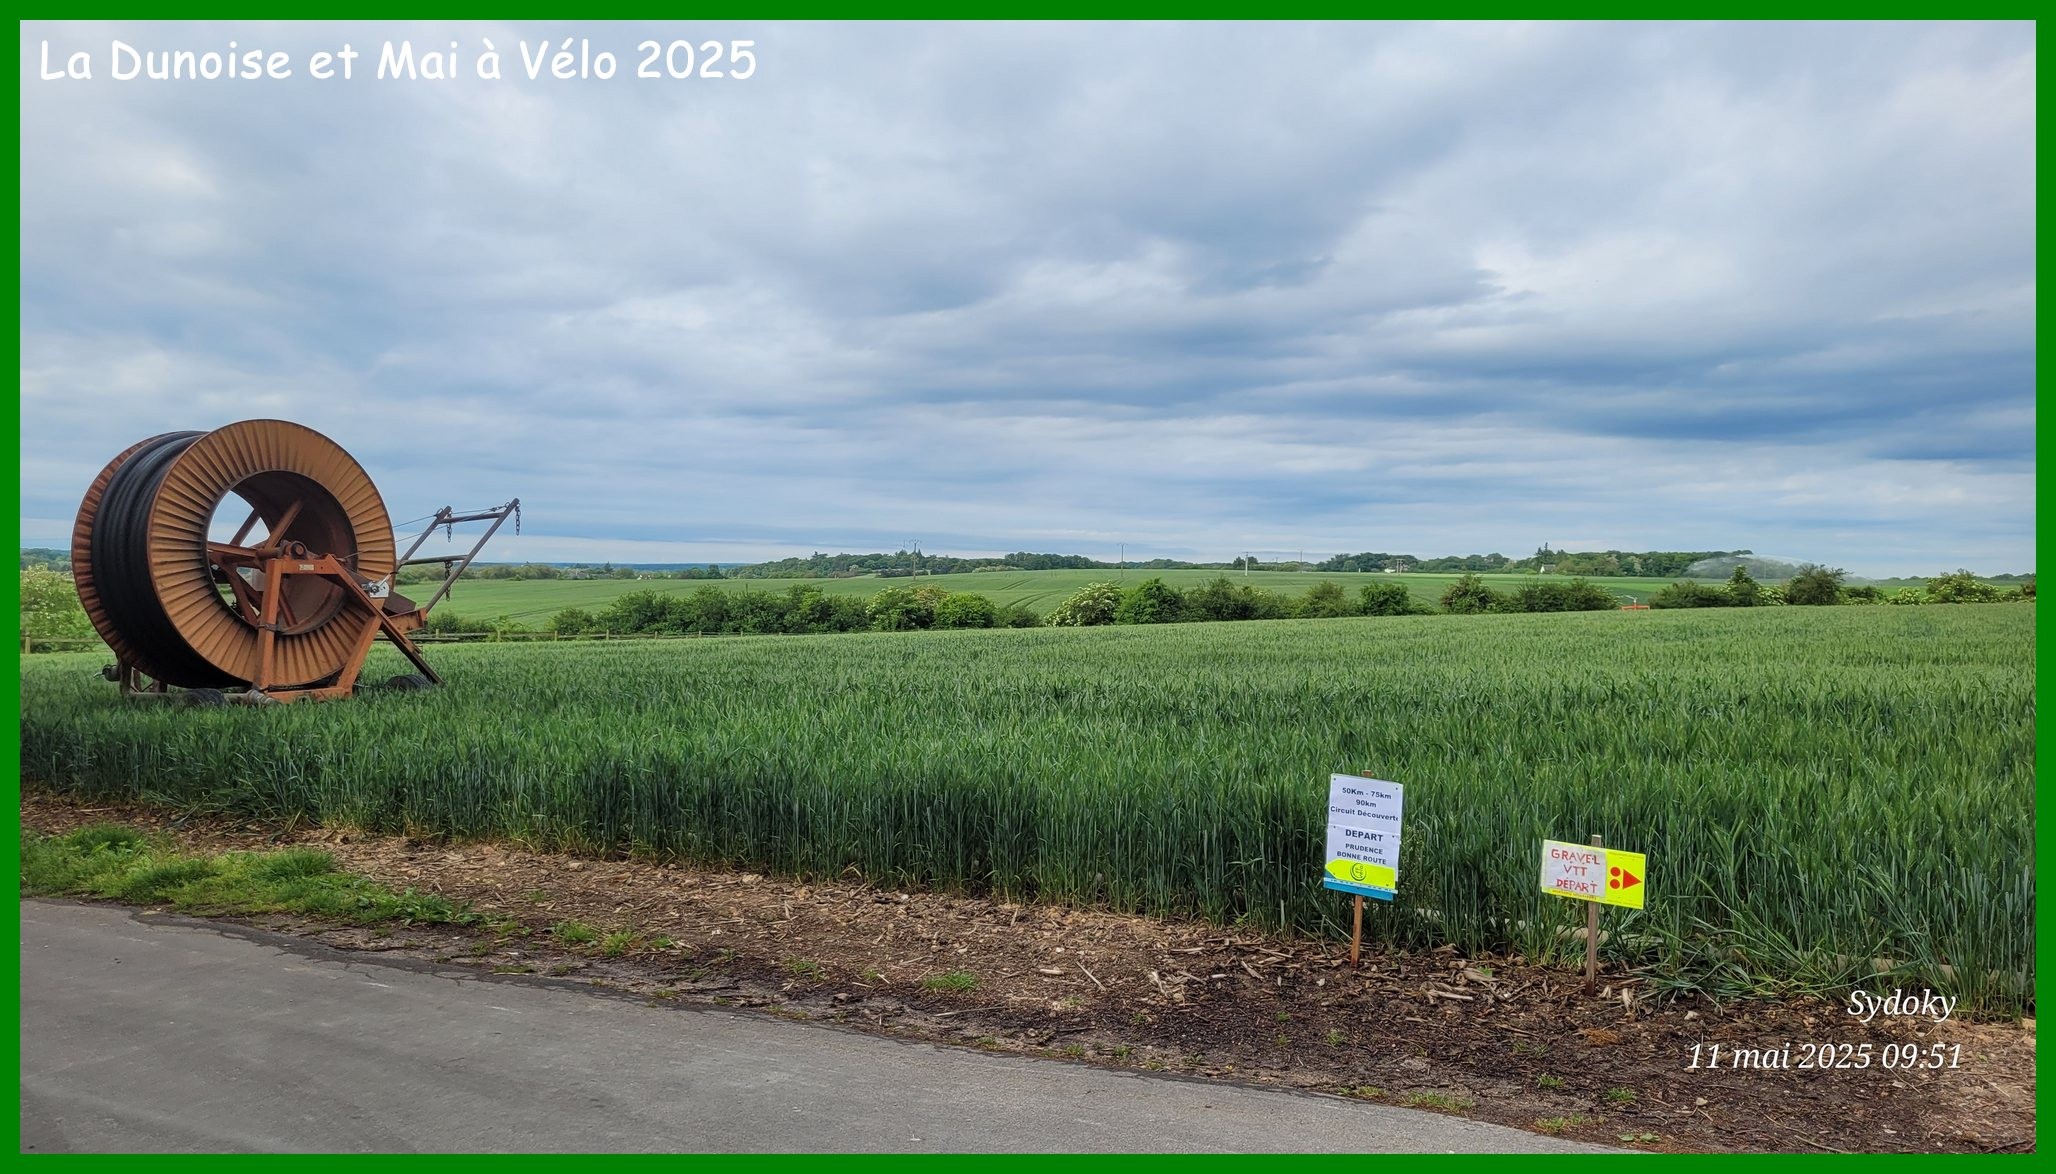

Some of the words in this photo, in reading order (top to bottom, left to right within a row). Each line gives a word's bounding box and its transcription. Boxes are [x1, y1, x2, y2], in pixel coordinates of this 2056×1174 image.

[1342, 787, 1364, 796] 50Km
[1371, 790, 1392, 800] 75km
[1330, 805, 1355, 815] Circuit
[1355, 799, 1377, 808] 90km
[1345, 829, 1384, 842] DEPART
[1345, 843, 1383, 855] PRUDENCE
[1337, 850, 1361, 860] BONNE
[1363, 855, 1386, 865] ROUTE
[1563, 864, 1588, 877] VTT
